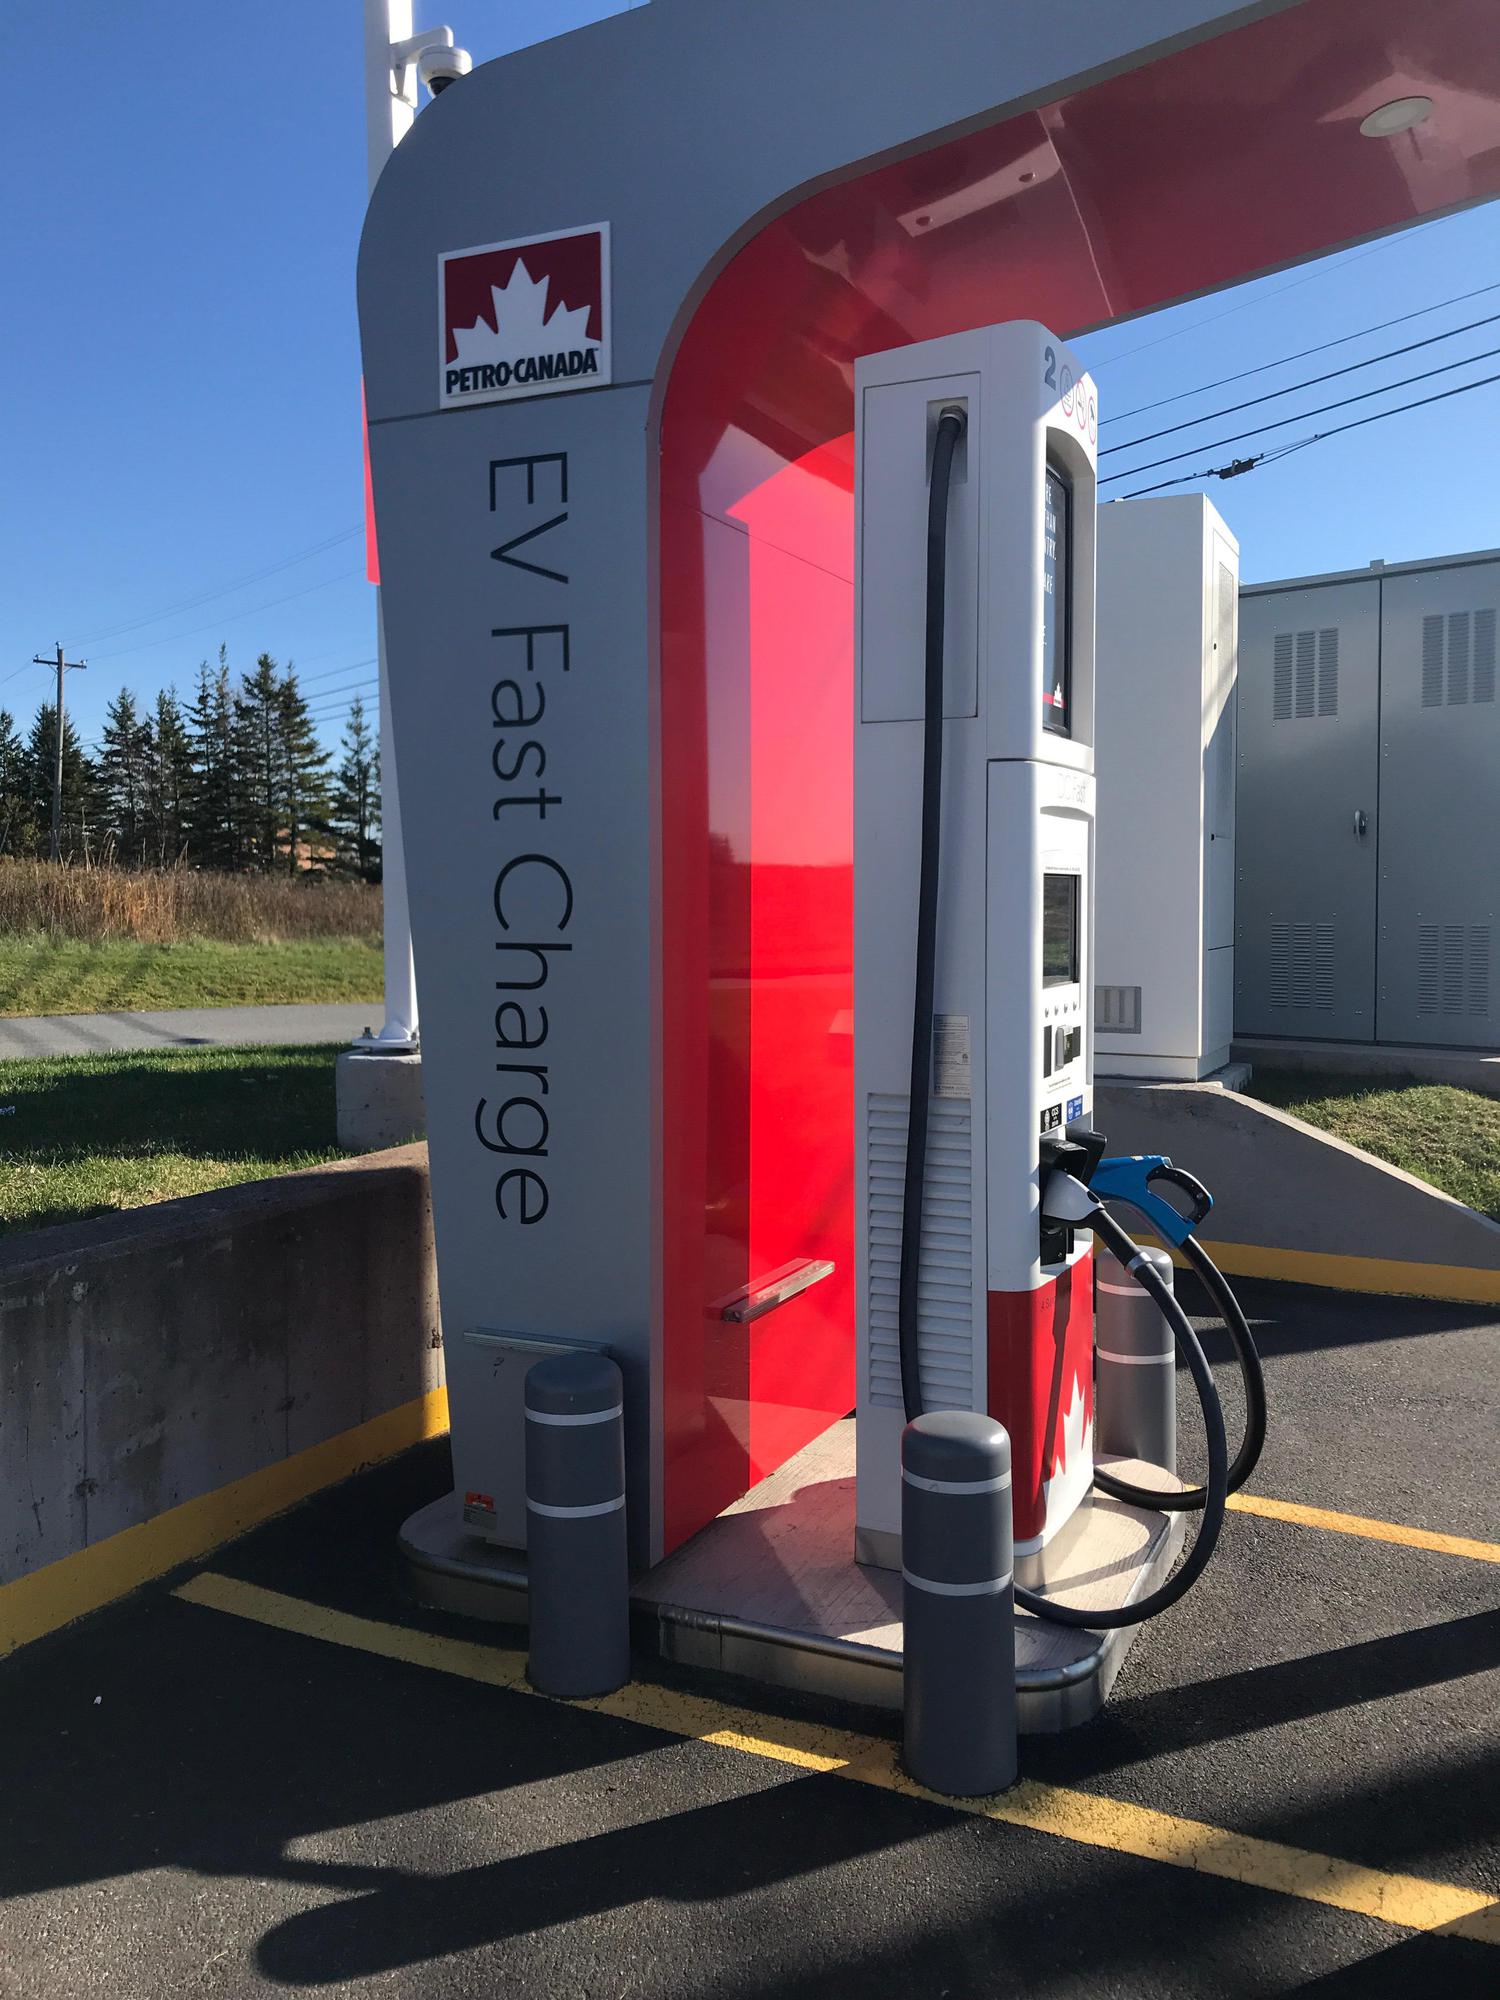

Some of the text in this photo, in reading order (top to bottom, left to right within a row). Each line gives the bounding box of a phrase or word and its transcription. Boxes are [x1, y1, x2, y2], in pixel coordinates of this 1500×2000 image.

[1044, 345, 1056, 391] 2
[474, 451, 574, 1225] EV Fast Charge
